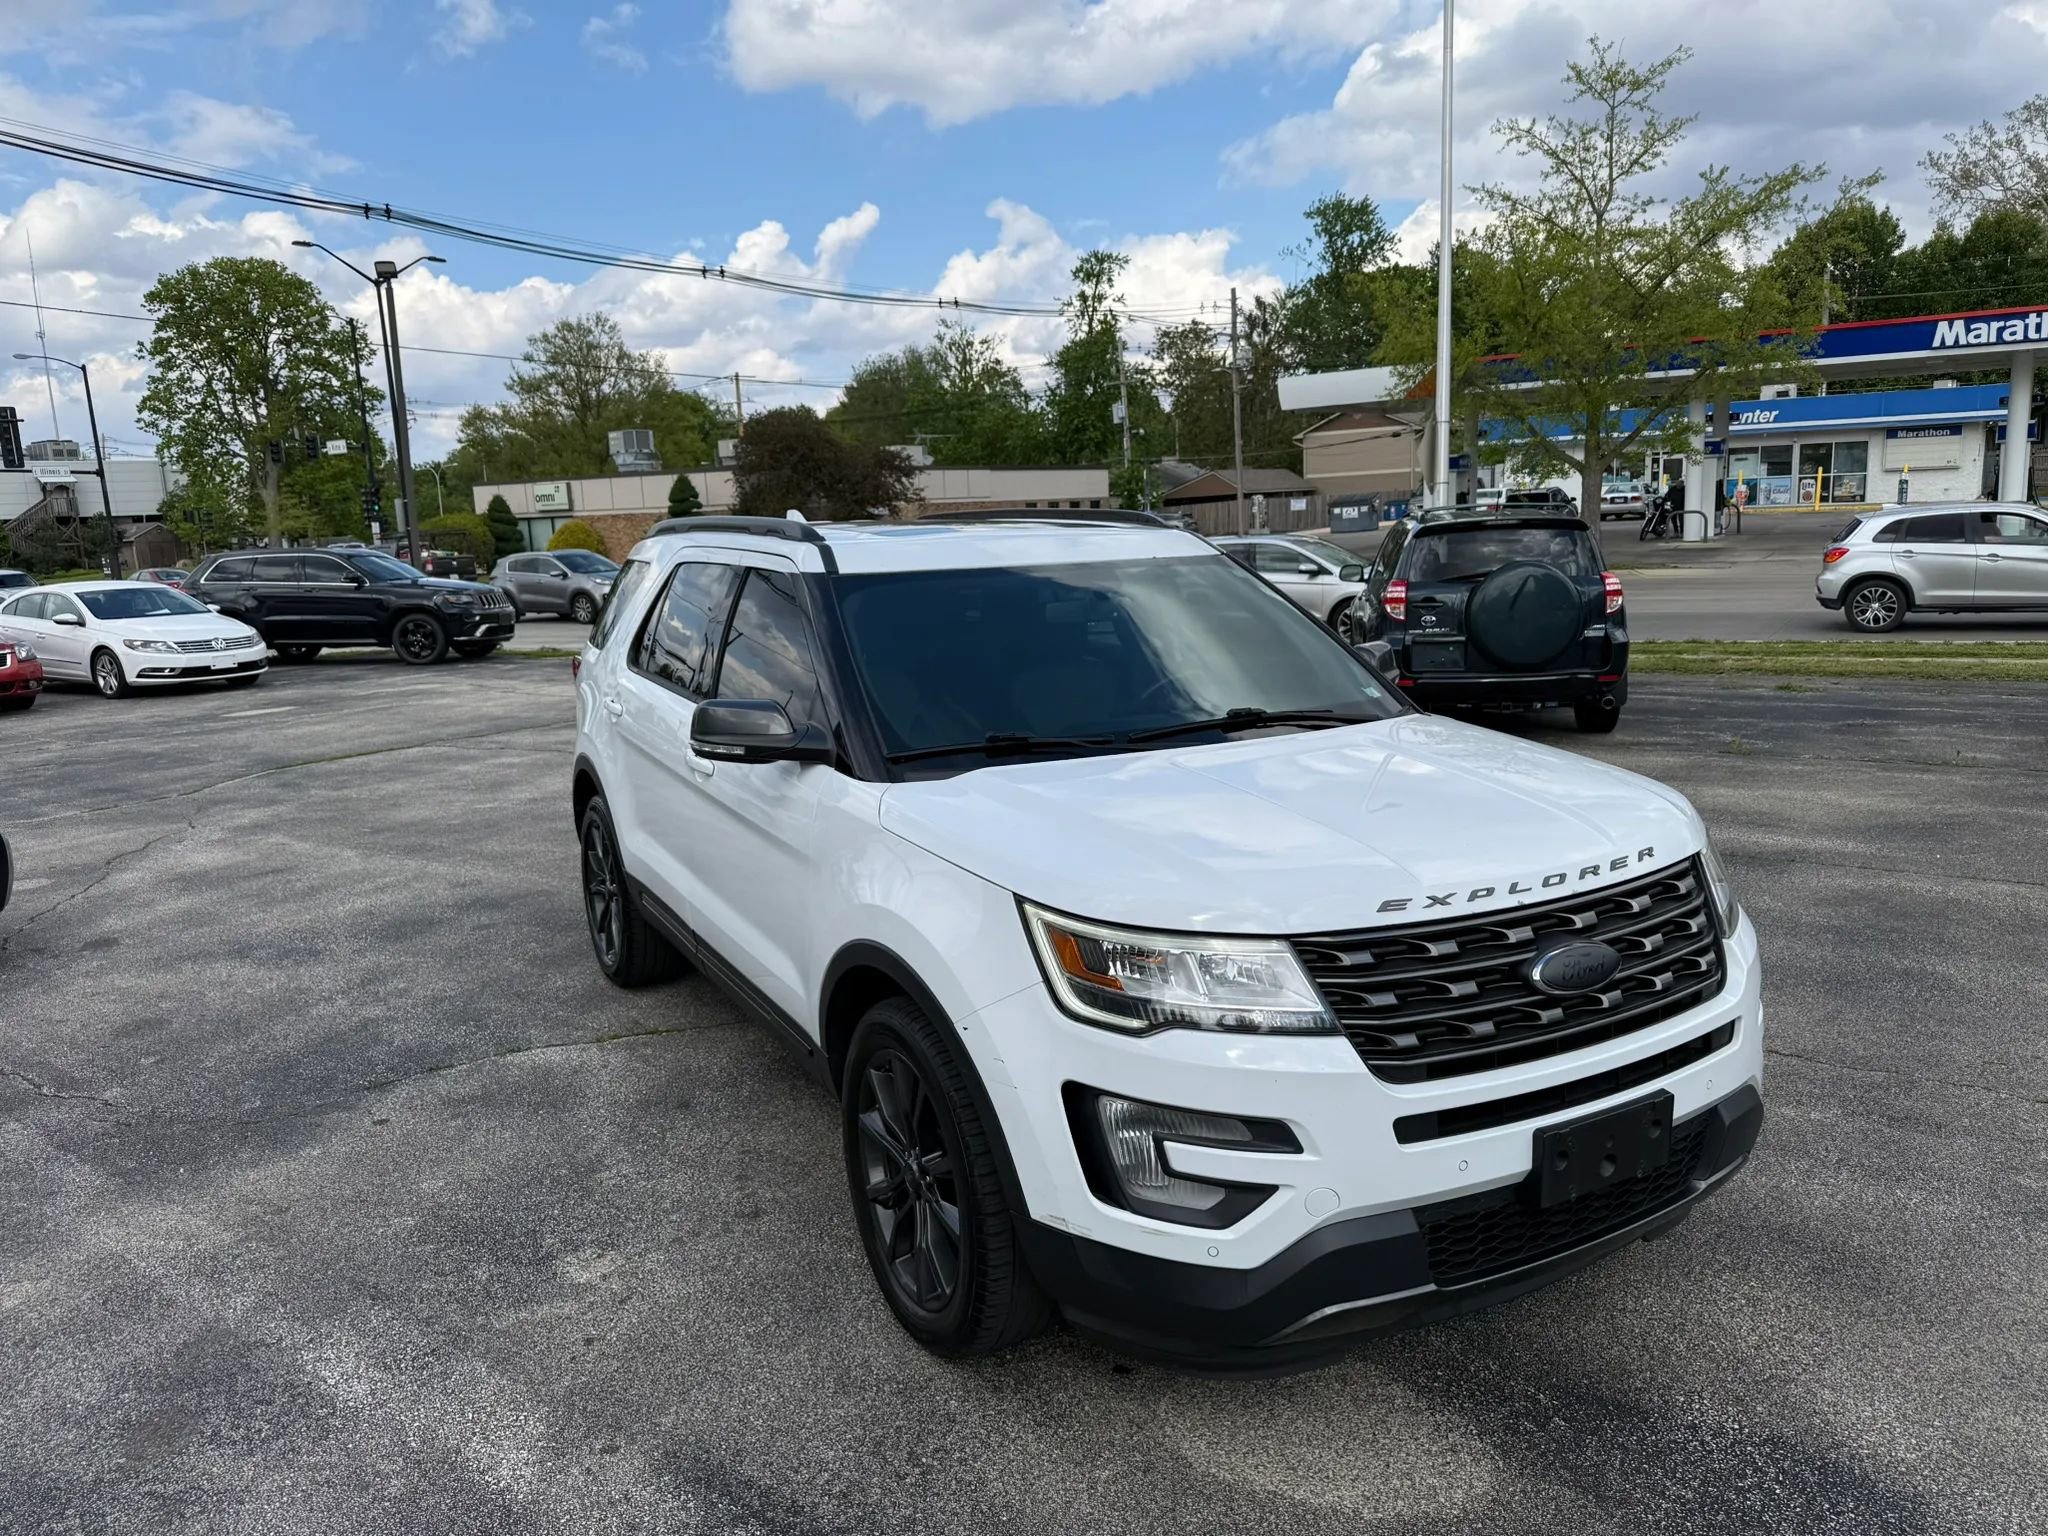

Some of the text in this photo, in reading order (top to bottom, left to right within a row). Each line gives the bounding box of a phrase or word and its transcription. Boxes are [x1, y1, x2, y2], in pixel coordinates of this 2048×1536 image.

[1897, 428, 1950, 438] Marathon
[535, 494, 555, 503] omni
[1376, 846, 1656, 912] EXPLORER
